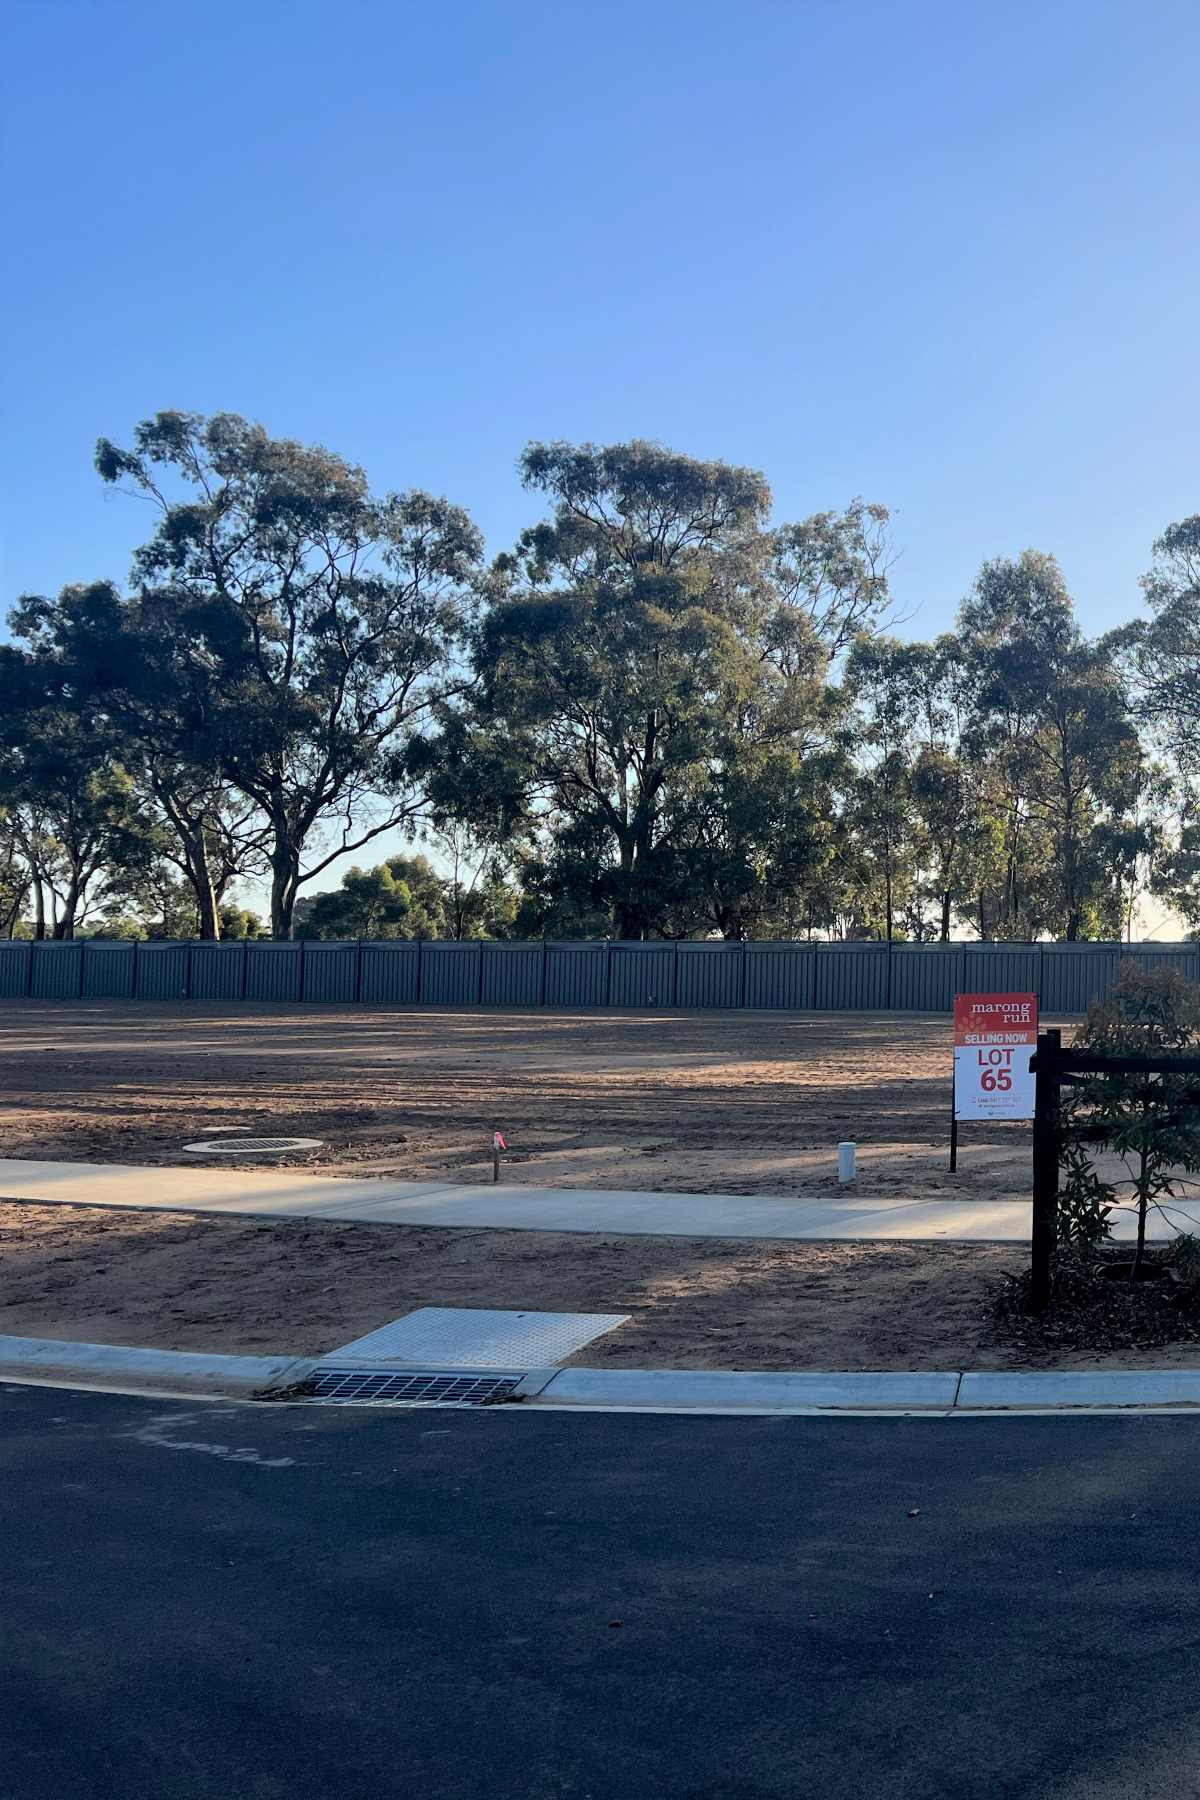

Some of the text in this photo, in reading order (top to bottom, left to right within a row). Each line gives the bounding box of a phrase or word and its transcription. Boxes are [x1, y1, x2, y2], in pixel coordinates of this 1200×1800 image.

[972, 1003, 1030, 1014] marong
[1003, 1014, 1031, 1022] run
[965, 1033, 1027, 1044] SELLING NOW
[978, 1048, 1014, 1066] LOT
[981, 1069, 1012, 1092] 65
